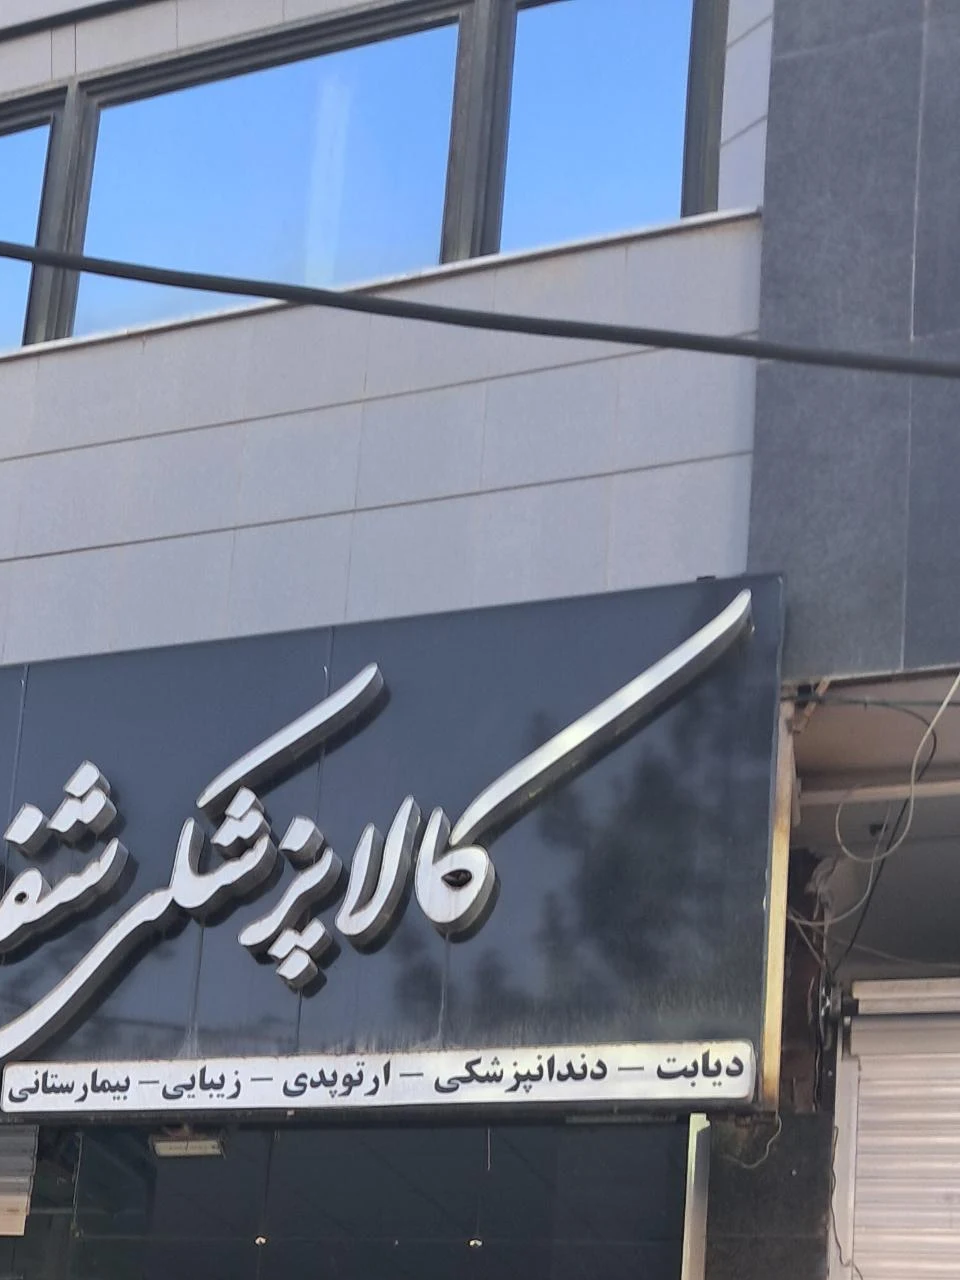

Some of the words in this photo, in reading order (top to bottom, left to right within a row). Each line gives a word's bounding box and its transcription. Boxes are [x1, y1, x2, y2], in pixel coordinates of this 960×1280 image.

[8, 1067, 131, 1103] بیمارستانی
[161, 1064, 241, 1100] زیبایی
[282, 1060, 391, 1099] ارتوپدی
[434, 1052, 608, 1094] دندانپزشکی
[656, 1049, 745, 1087] دیابت
